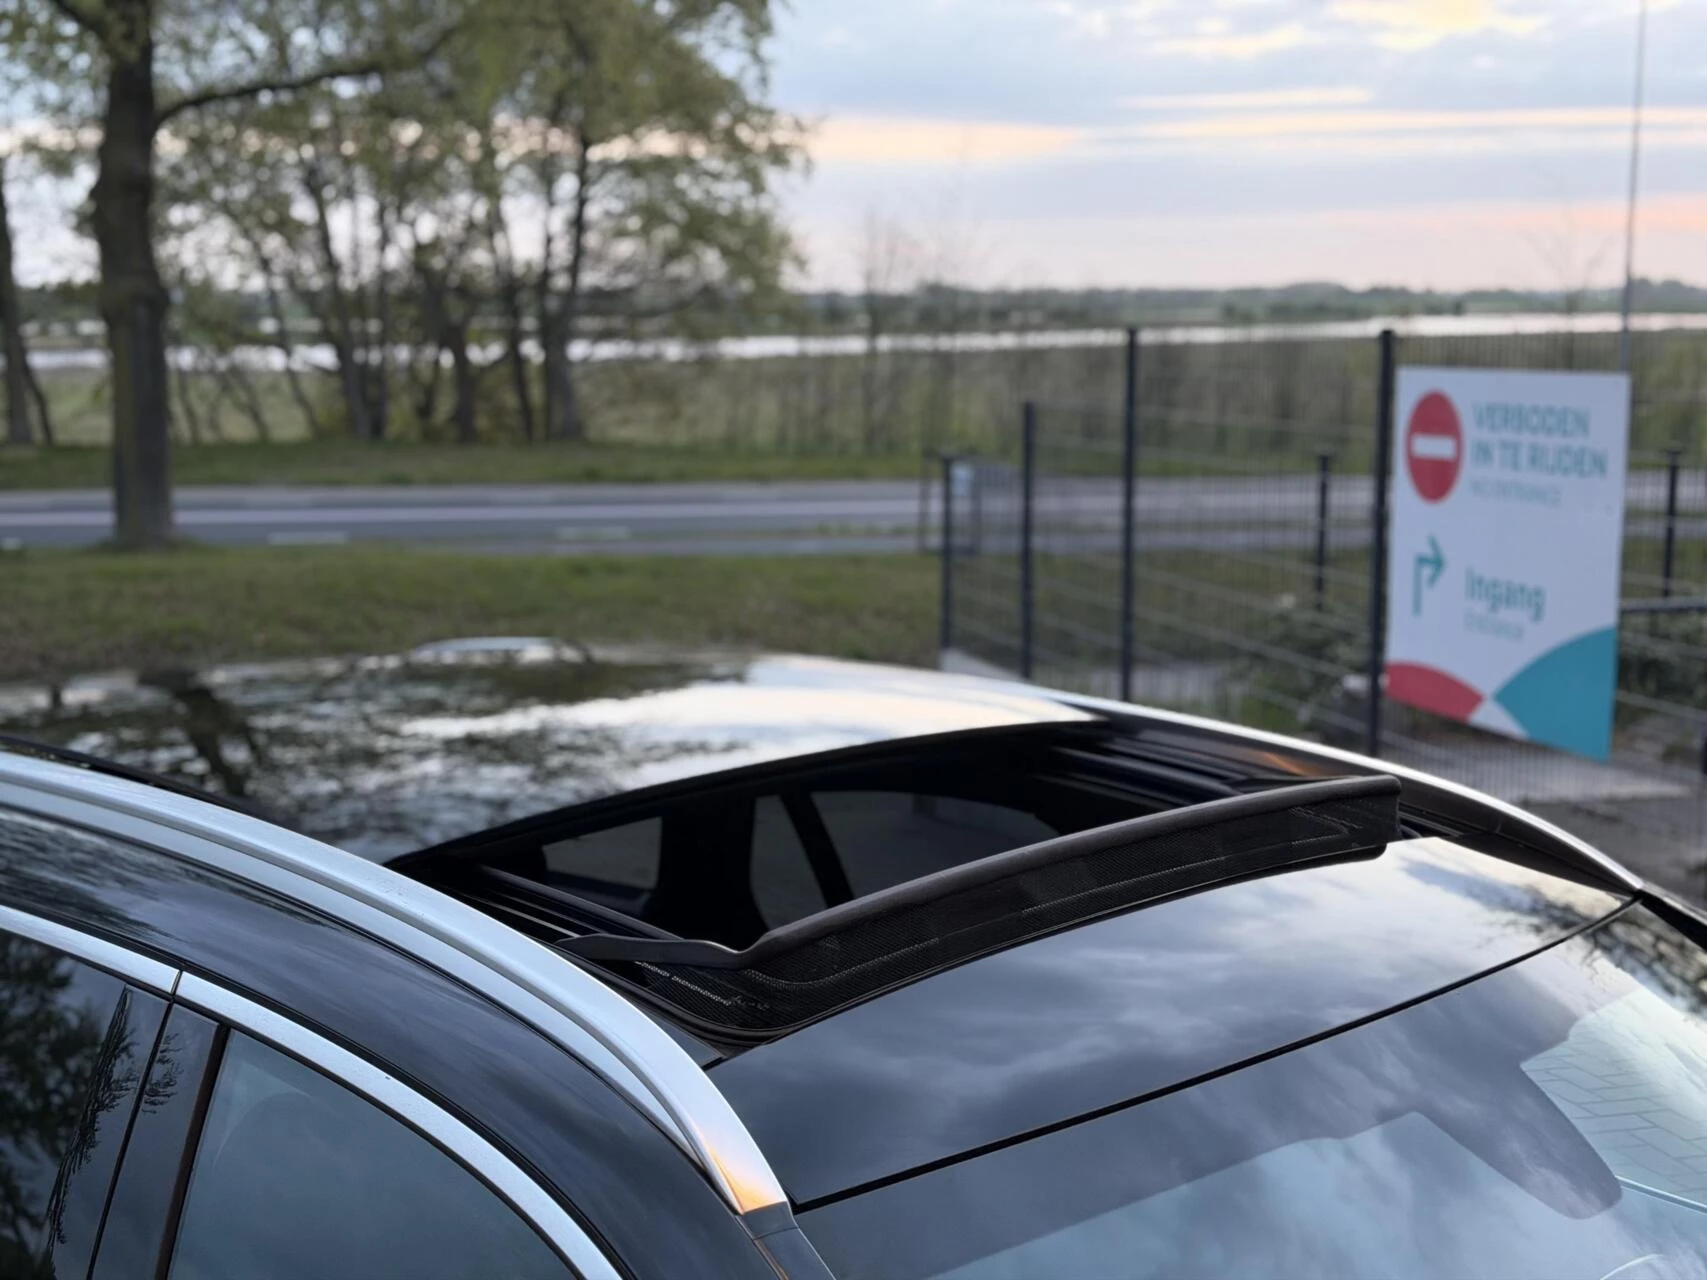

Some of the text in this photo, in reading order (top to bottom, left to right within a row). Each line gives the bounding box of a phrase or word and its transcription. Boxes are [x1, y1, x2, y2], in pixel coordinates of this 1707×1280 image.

[1472, 403, 1590, 438] VERBODEN
[1471, 439, 1608, 478] IN TE RIJDEN
[1465, 568, 1546, 622] Ingang
